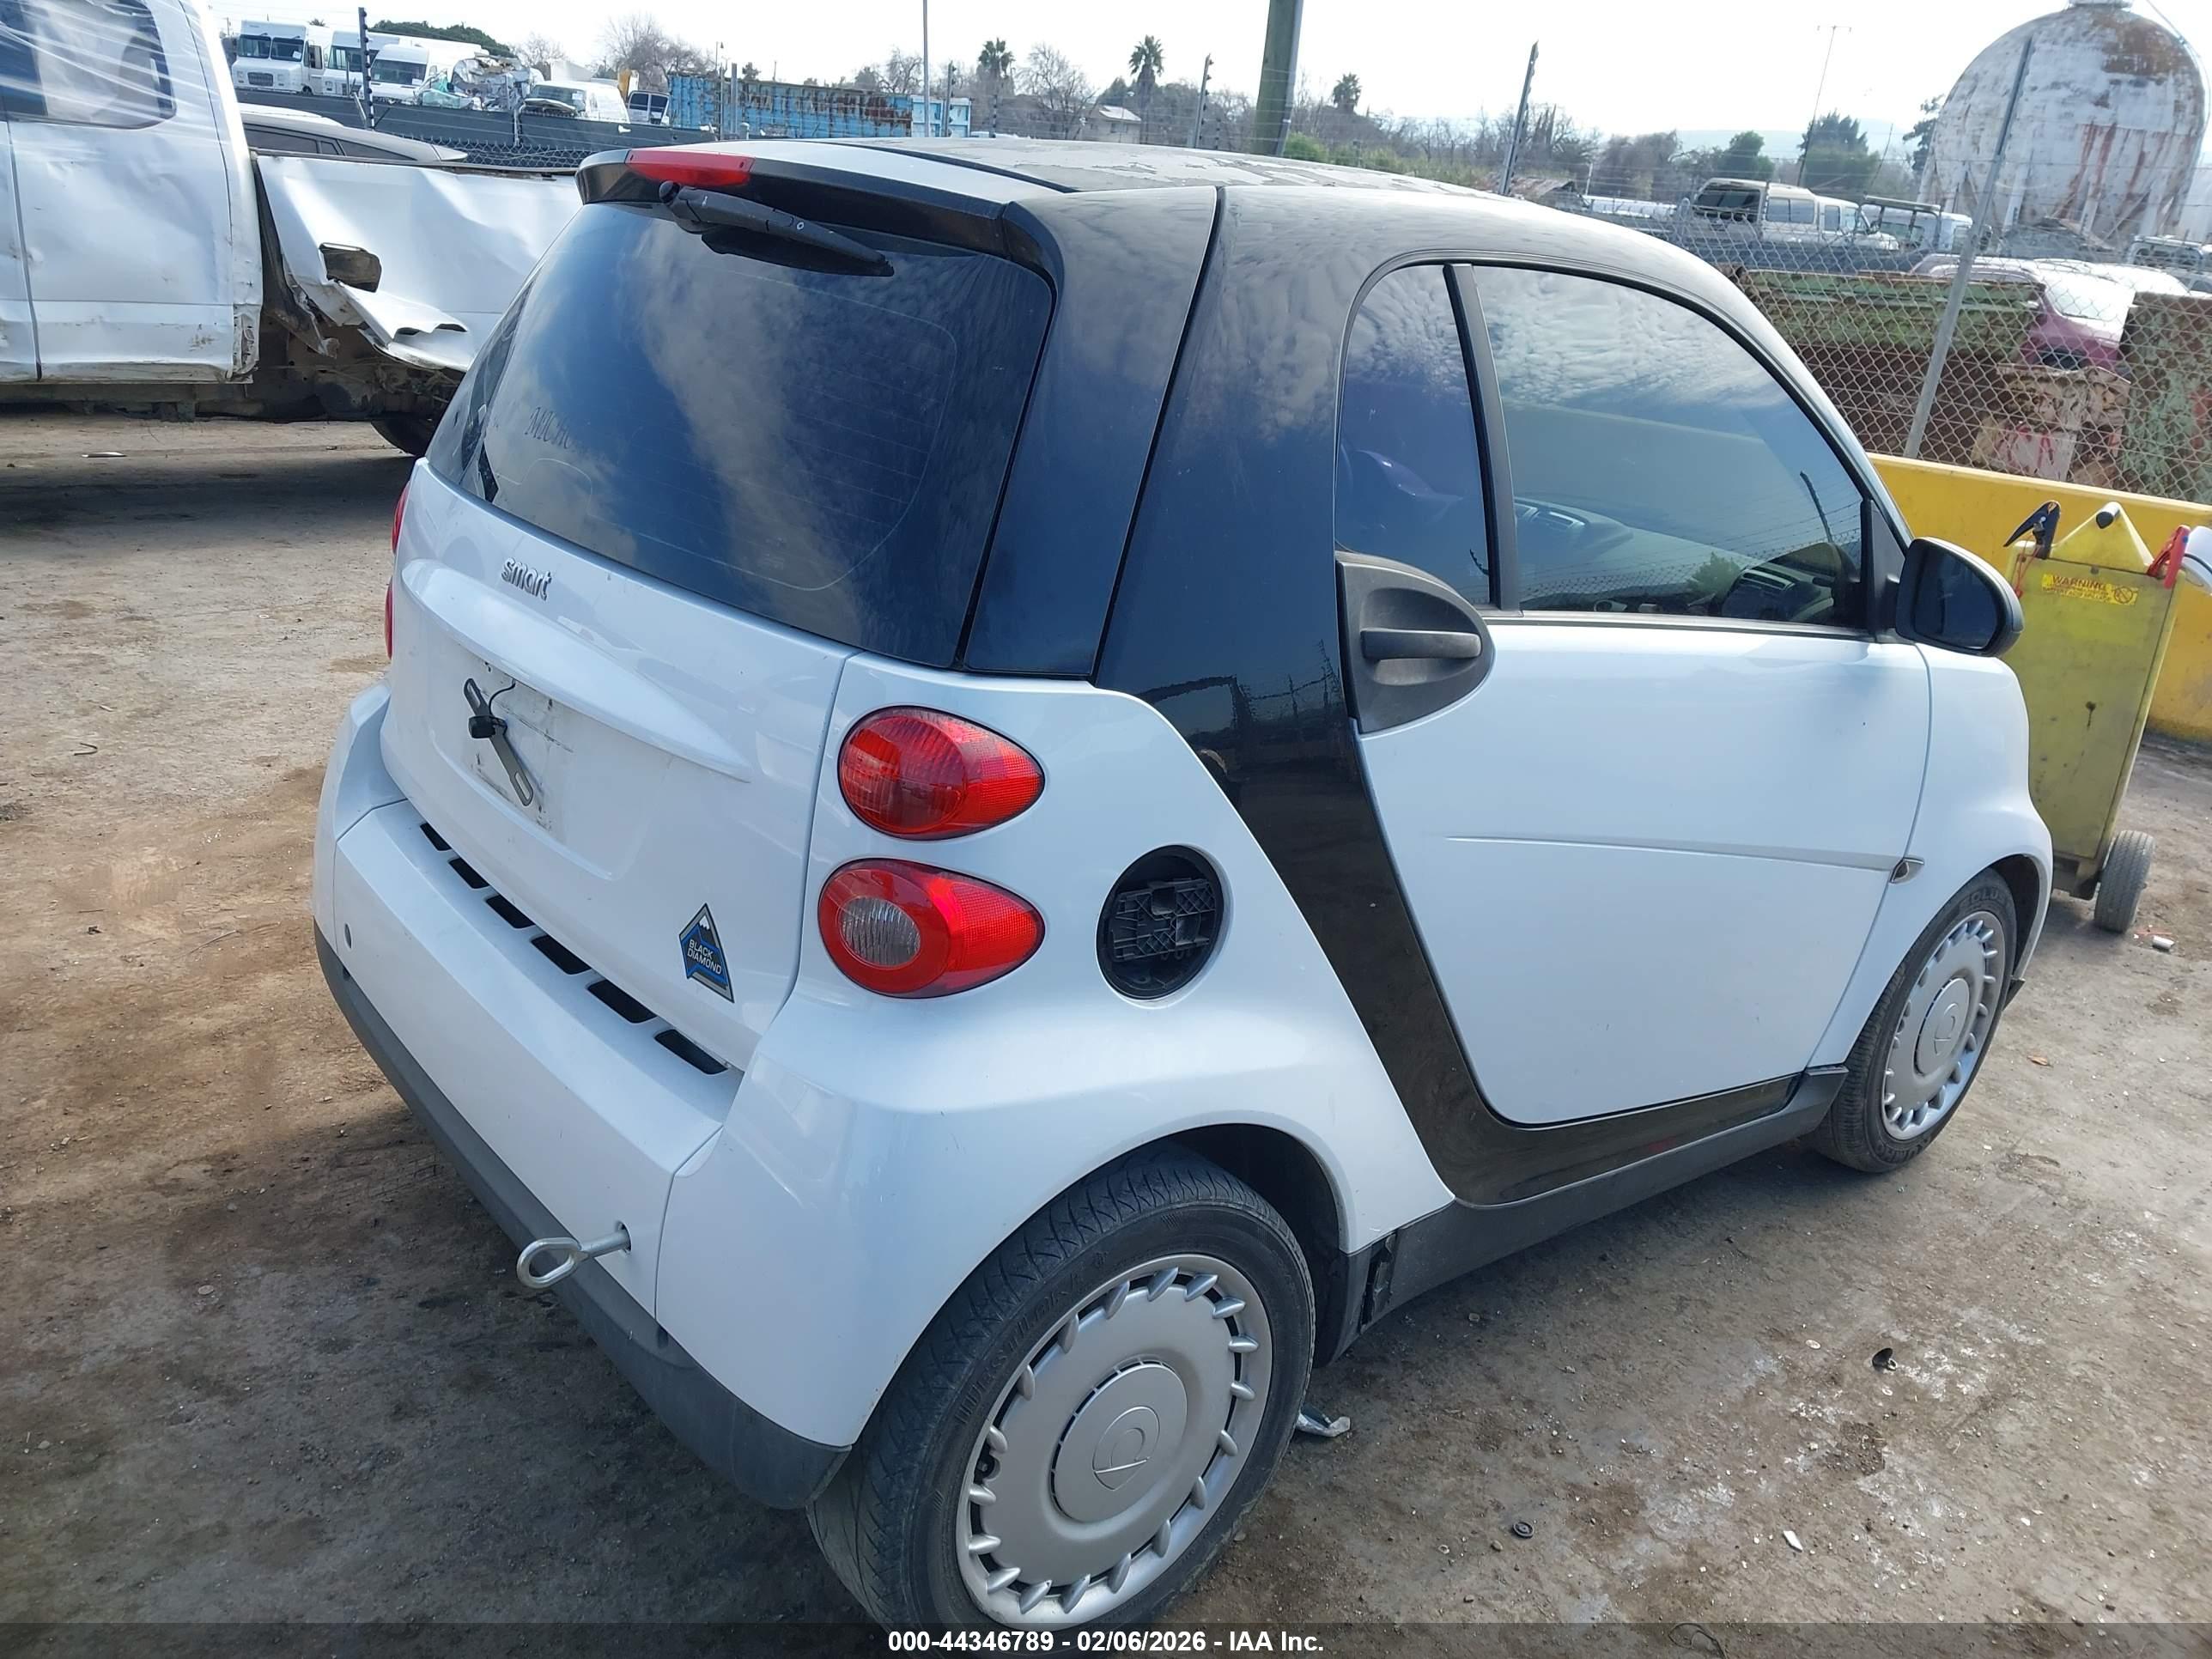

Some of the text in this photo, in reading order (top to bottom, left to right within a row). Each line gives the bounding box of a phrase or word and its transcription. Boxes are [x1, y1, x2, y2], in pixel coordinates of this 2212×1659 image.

[501, 557, 552, 601] smart
[687, 948, 722, 975] DIAMOND
[689, 939, 714, 959] BLACK
